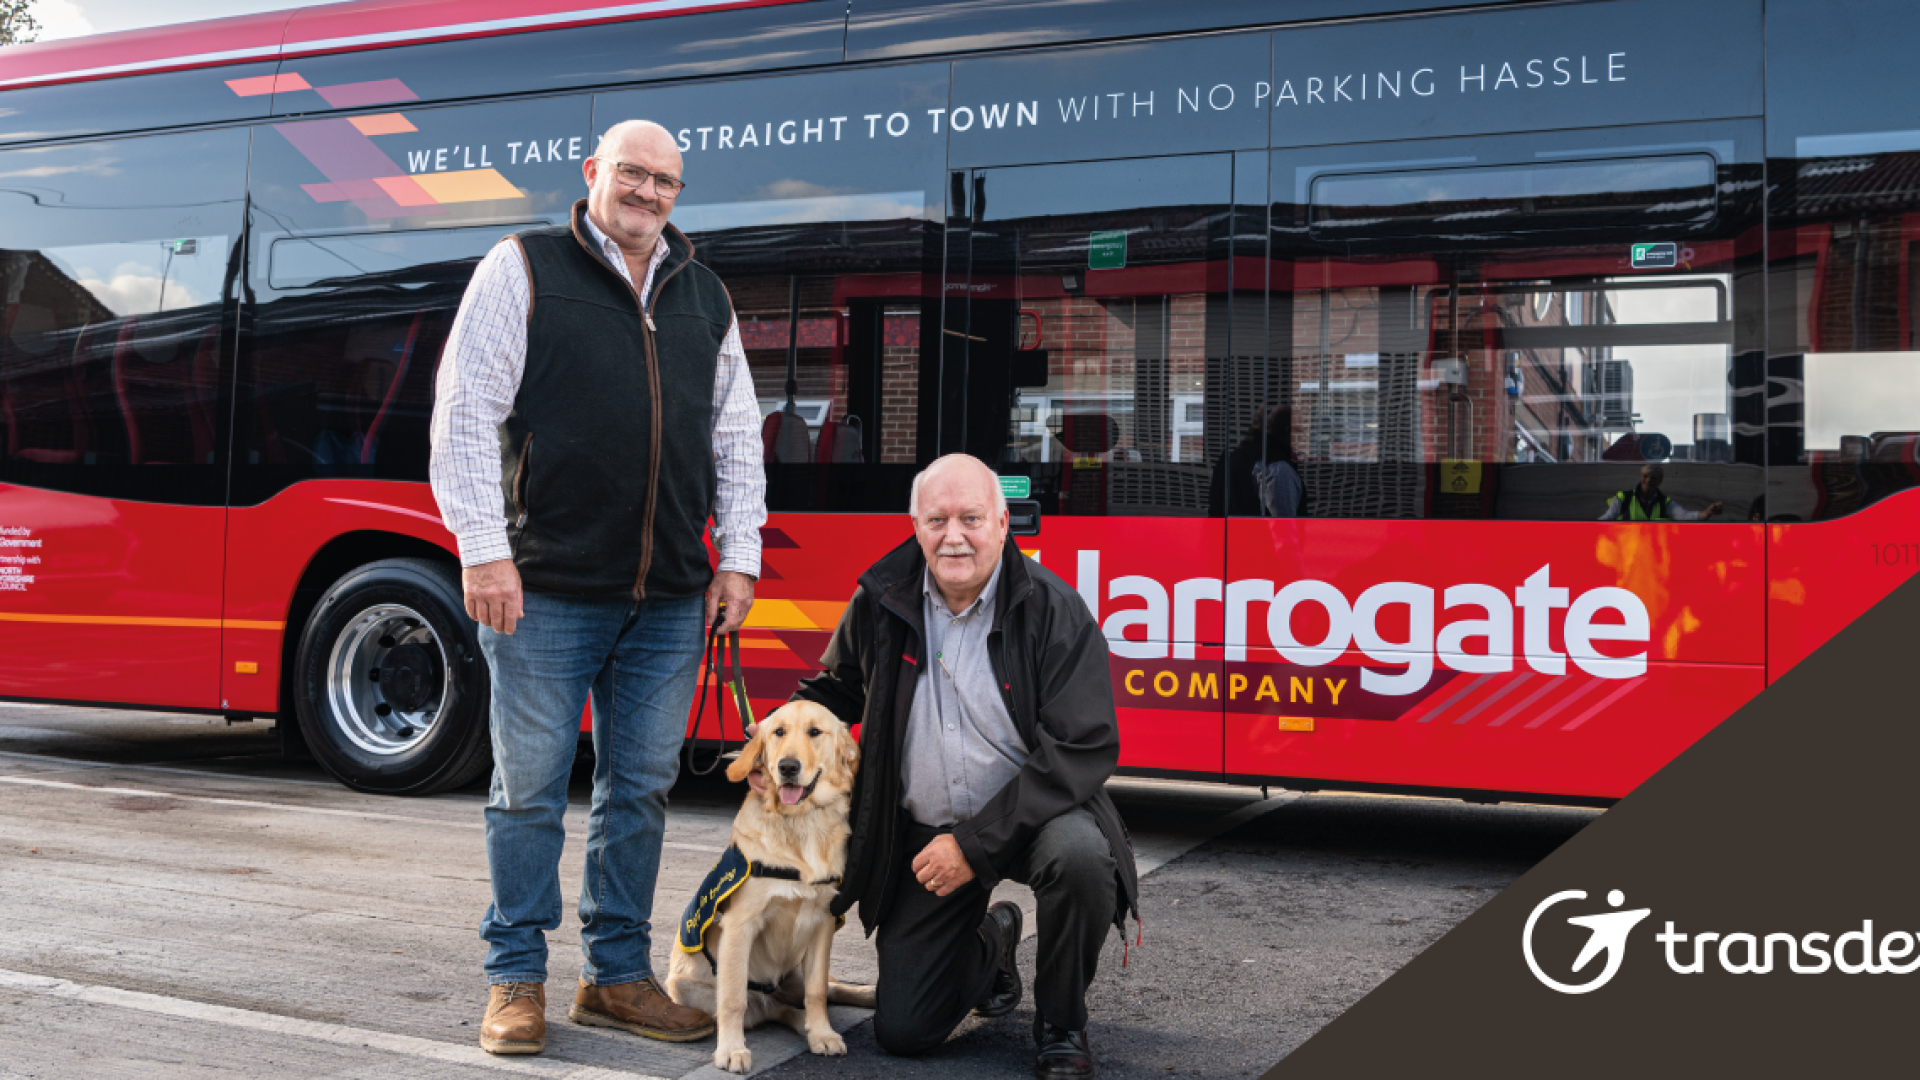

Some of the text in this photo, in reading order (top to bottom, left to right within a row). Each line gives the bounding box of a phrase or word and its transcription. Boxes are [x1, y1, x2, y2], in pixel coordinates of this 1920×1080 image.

[408, 51, 1627, 174] WE'LL TAKE STRAIGHT TO TOWN WITH NO PARKING HASSLE
[1870, 542, 1920, 566] 1011
[1124, 669, 1348, 705] COMPANY
